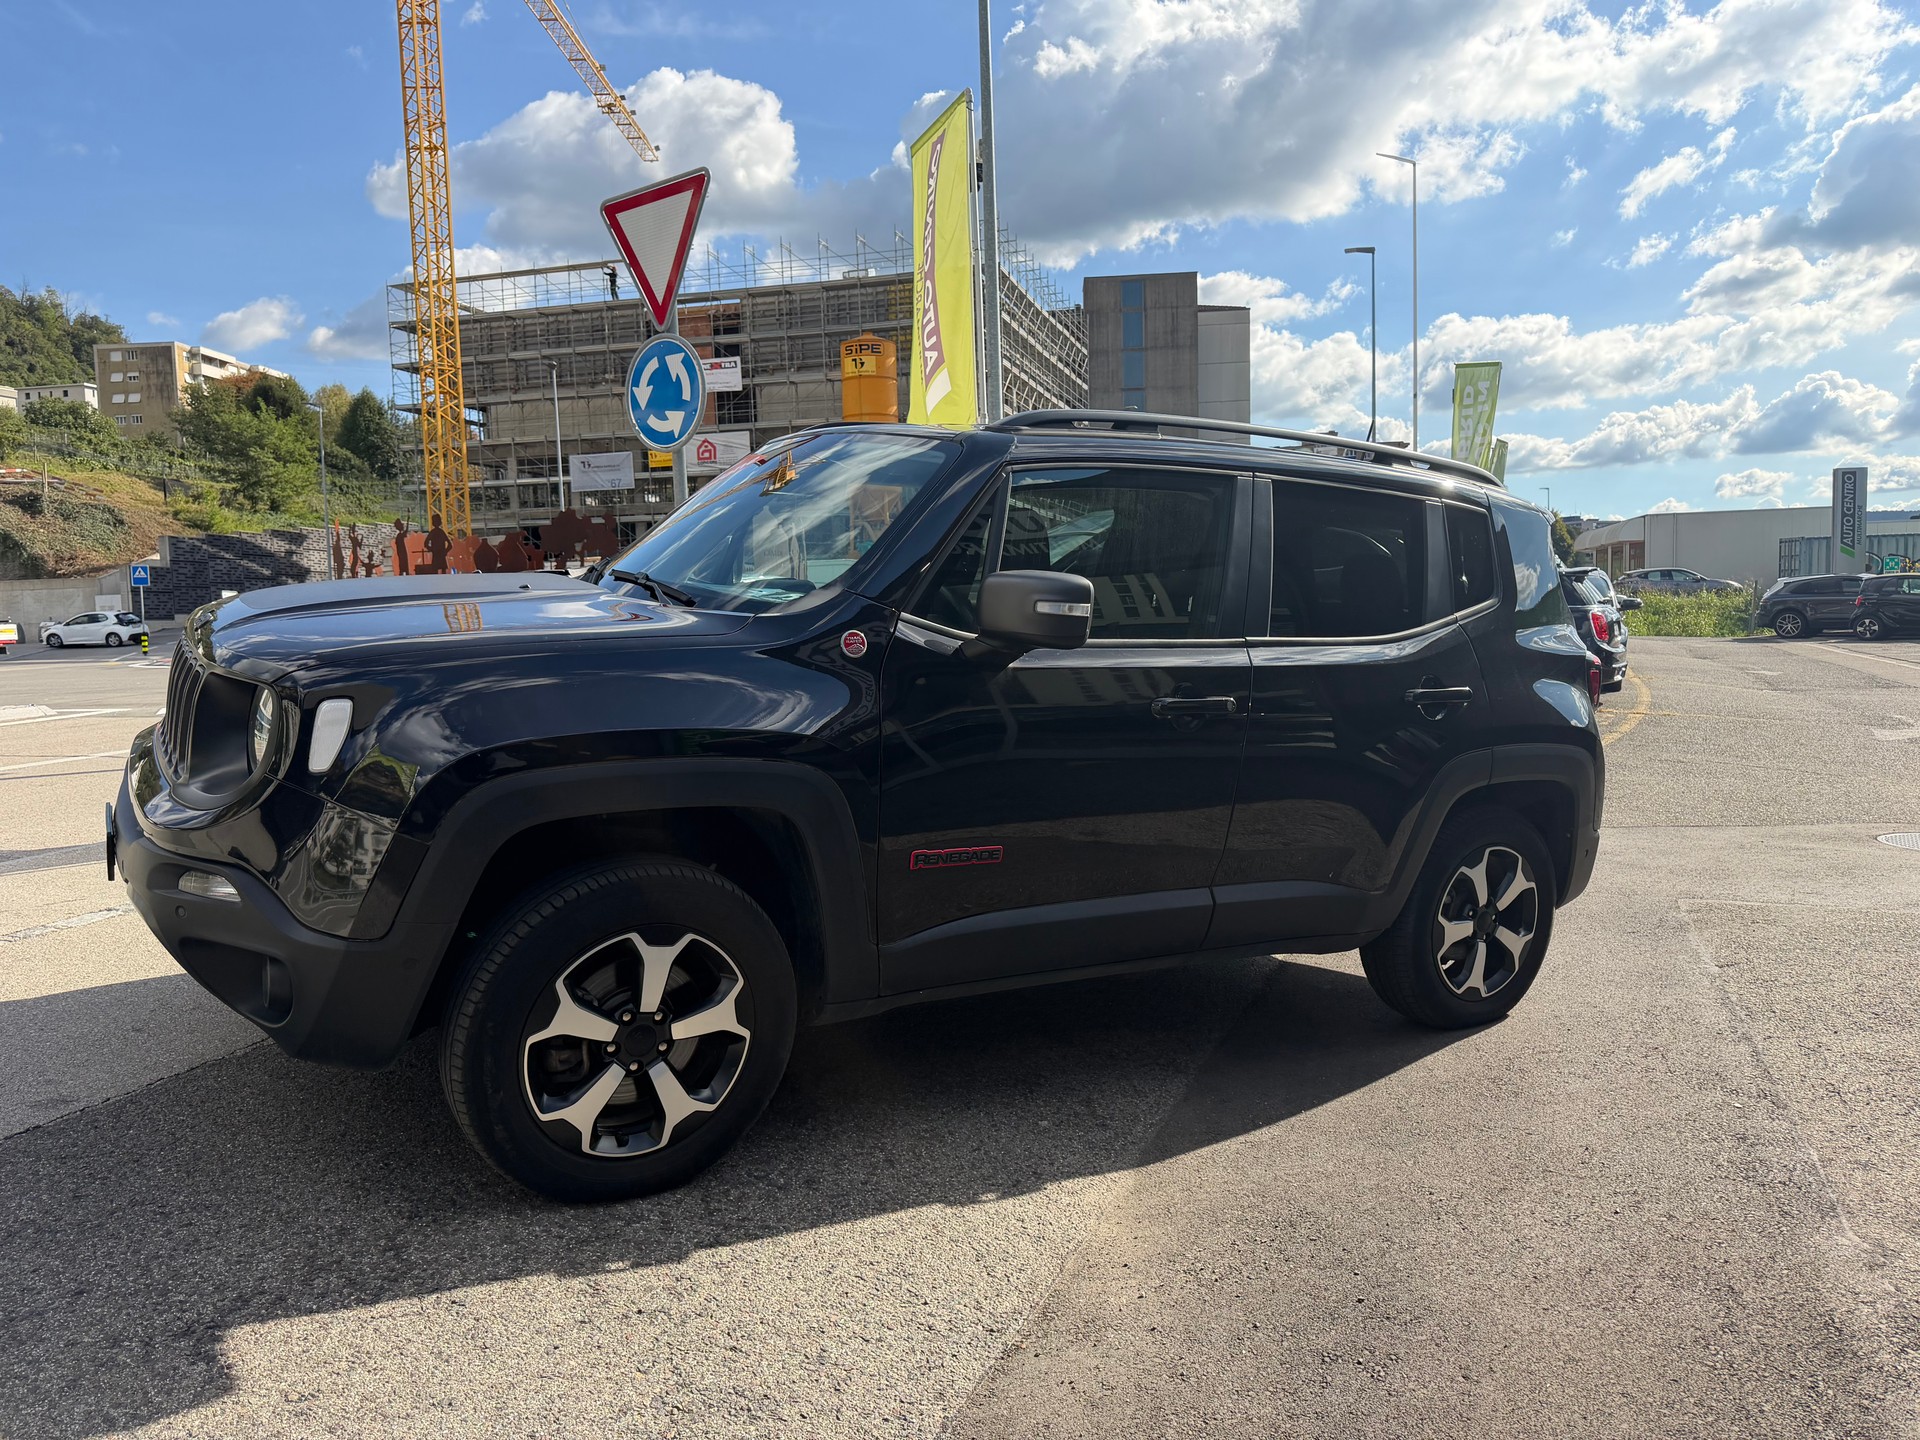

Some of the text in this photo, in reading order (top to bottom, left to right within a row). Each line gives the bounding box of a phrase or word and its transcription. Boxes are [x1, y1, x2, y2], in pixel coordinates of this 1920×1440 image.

[610, 478, 622, 488] 67
[1843, 474, 1855, 546] AUTO CENTRO
[913, 849, 1001, 869] RENEGADE
